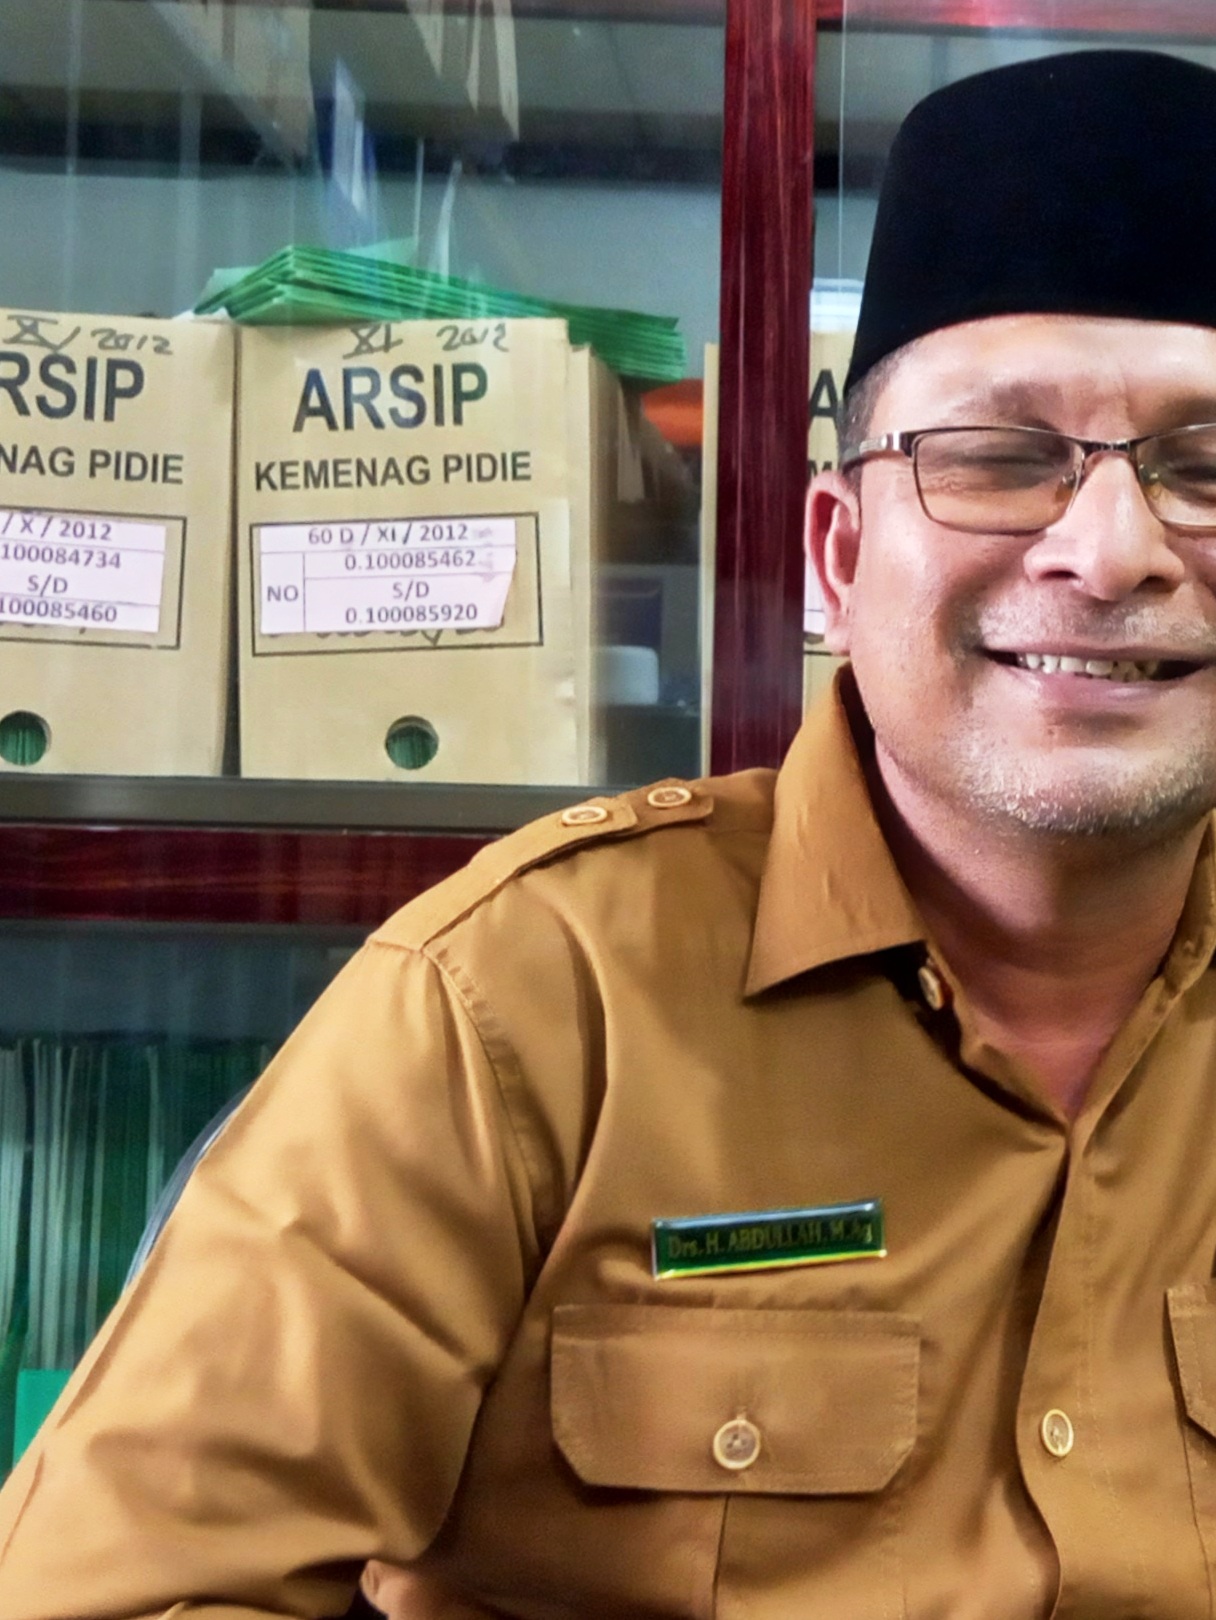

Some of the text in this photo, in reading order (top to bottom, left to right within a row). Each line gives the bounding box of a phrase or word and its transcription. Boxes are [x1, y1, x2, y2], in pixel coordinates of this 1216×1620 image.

[292, 362, 489, 433] ARSIP
[89, 449, 184, 486] PIDIE
[255, 451, 532, 491] KEMENAG PIDIE
[20, 515, 34, 534] X
[59, 519, 112, 541] 2012
[308, 527, 333, 545] 60
[340, 528, 354, 545] D
[377, 526, 397, 543] XI
[420, 524, 468, 542] 2012
[345, 550, 476, 571] 0.100085462
[27, 574, 68, 597] S/D
[266, 584, 299, 602] NO
[392, 580, 430, 602] S/D
[345, 603, 478, 624] 0.100085920
